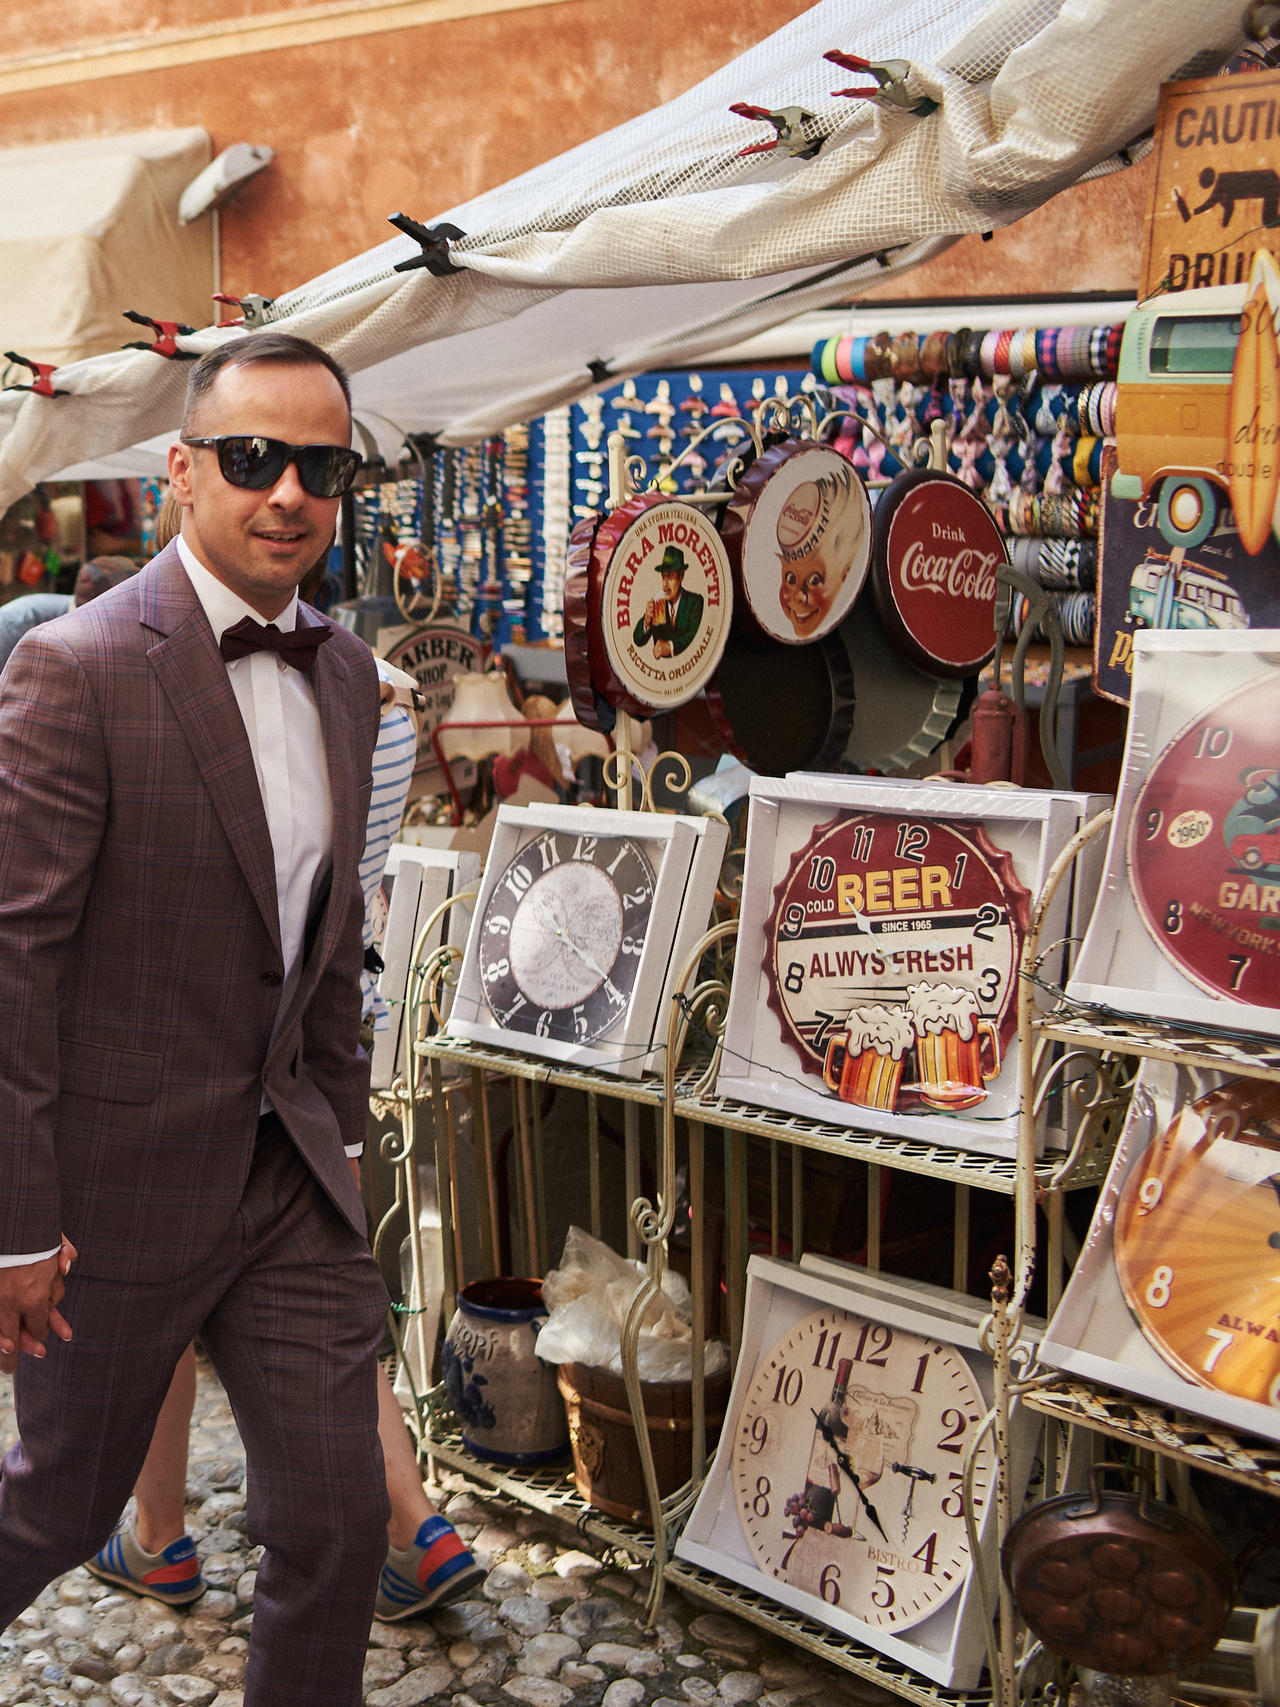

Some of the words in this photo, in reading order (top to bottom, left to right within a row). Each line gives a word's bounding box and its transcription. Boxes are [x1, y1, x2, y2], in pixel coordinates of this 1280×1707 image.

[1175, 99, 1280, 148] CAUTI
[1169, 251, 1274, 293] DRU
[931, 522, 966, 543] Drink
[617, 536, 655, 630] BIRRA
[658, 522, 720, 607] MORETTI
[402, 638, 474, 674] ARBER
[627, 644, 667, 682] RICETTA
[668, 626, 714, 681] ORIGINALE
[416, 663, 448, 687] SHOP
[1194, 726, 1233, 759] 10
[895, 823, 929, 862] 12
[1145, 808, 1164, 841] 9
[1177, 820, 1205, 843] 1960
[538, 834, 561, 872] 11
[572, 836, 599, 861] 12
[606, 844, 629, 876] 1
[852, 825, 874, 862] 11
[506, 864, 533, 902] 10
[808, 855, 836, 892] 10
[953, 853, 968, 889] 1
[622, 886, 647, 911] 2
[806, 899, 835, 914] COLD
[837, 865, 953, 915] BEER
[488, 915, 511, 936] 9
[783, 903, 806, 938] 9
[881, 921, 909, 934] SINCE
[911, 919, 932, 931] 1965
[973, 905, 1001, 942] 2
[1163, 900, 1183, 935] 8
[487, 958, 510, 982] 8
[784, 962, 806, 994] 8
[809, 950, 886, 979] ALWYS
[1228, 954, 1252, 991] 7
[603, 979, 626, 1006] 4
[977, 967, 1001, 1003] 3
[501, 992, 527, 1025] 7
[535, 1010, 553, 1038] 6
[573, 1004, 588, 1036] 5
[812, 1010, 834, 1048] 7
[1138, 1177, 1163, 1217] 9
[1146, 1265, 1174, 1308] 8
[812, 1329, 843, 1370] 11
[853, 1322, 894, 1368] 12
[1202, 1327, 1234, 1373] 7
[772, 1365, 803, 1407] 10
[911, 1352, 930, 1394] 1
[749, 1415, 769, 1454] 9
[937, 1408, 967, 1455] 2
[752, 1476, 771, 1518] 8
[941, 1472, 965, 1518] 3
[782, 1530, 805, 1571] 7
[867, 1545, 920, 1575] BISTRO
[912, 1532, 939, 1576] 4
[819, 1564, 842, 1605] 6
[871, 1565, 896, 1608] 5
